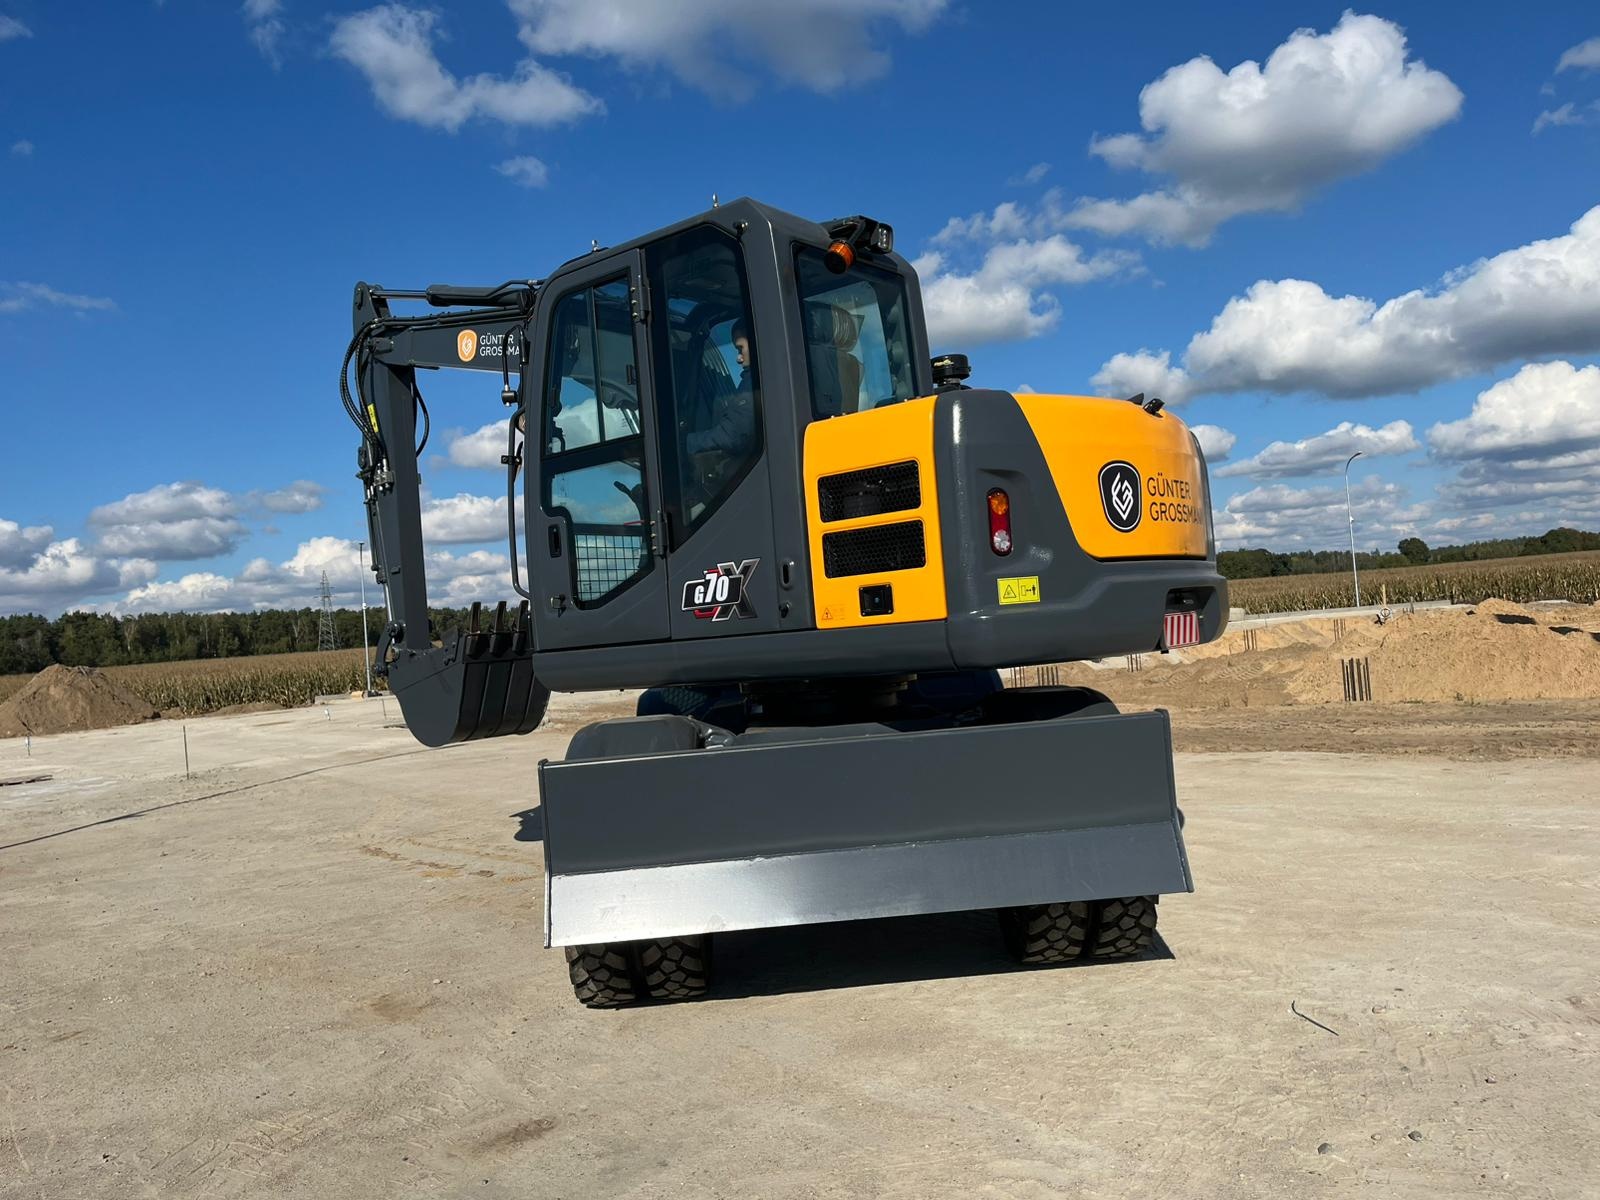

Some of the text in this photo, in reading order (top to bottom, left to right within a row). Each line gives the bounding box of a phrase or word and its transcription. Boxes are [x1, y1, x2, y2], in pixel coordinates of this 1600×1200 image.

[479, 332, 514, 345] GÜNTR
[479, 346, 520, 357] GROSMA
[1146, 471, 1192, 500] GÜNTER
